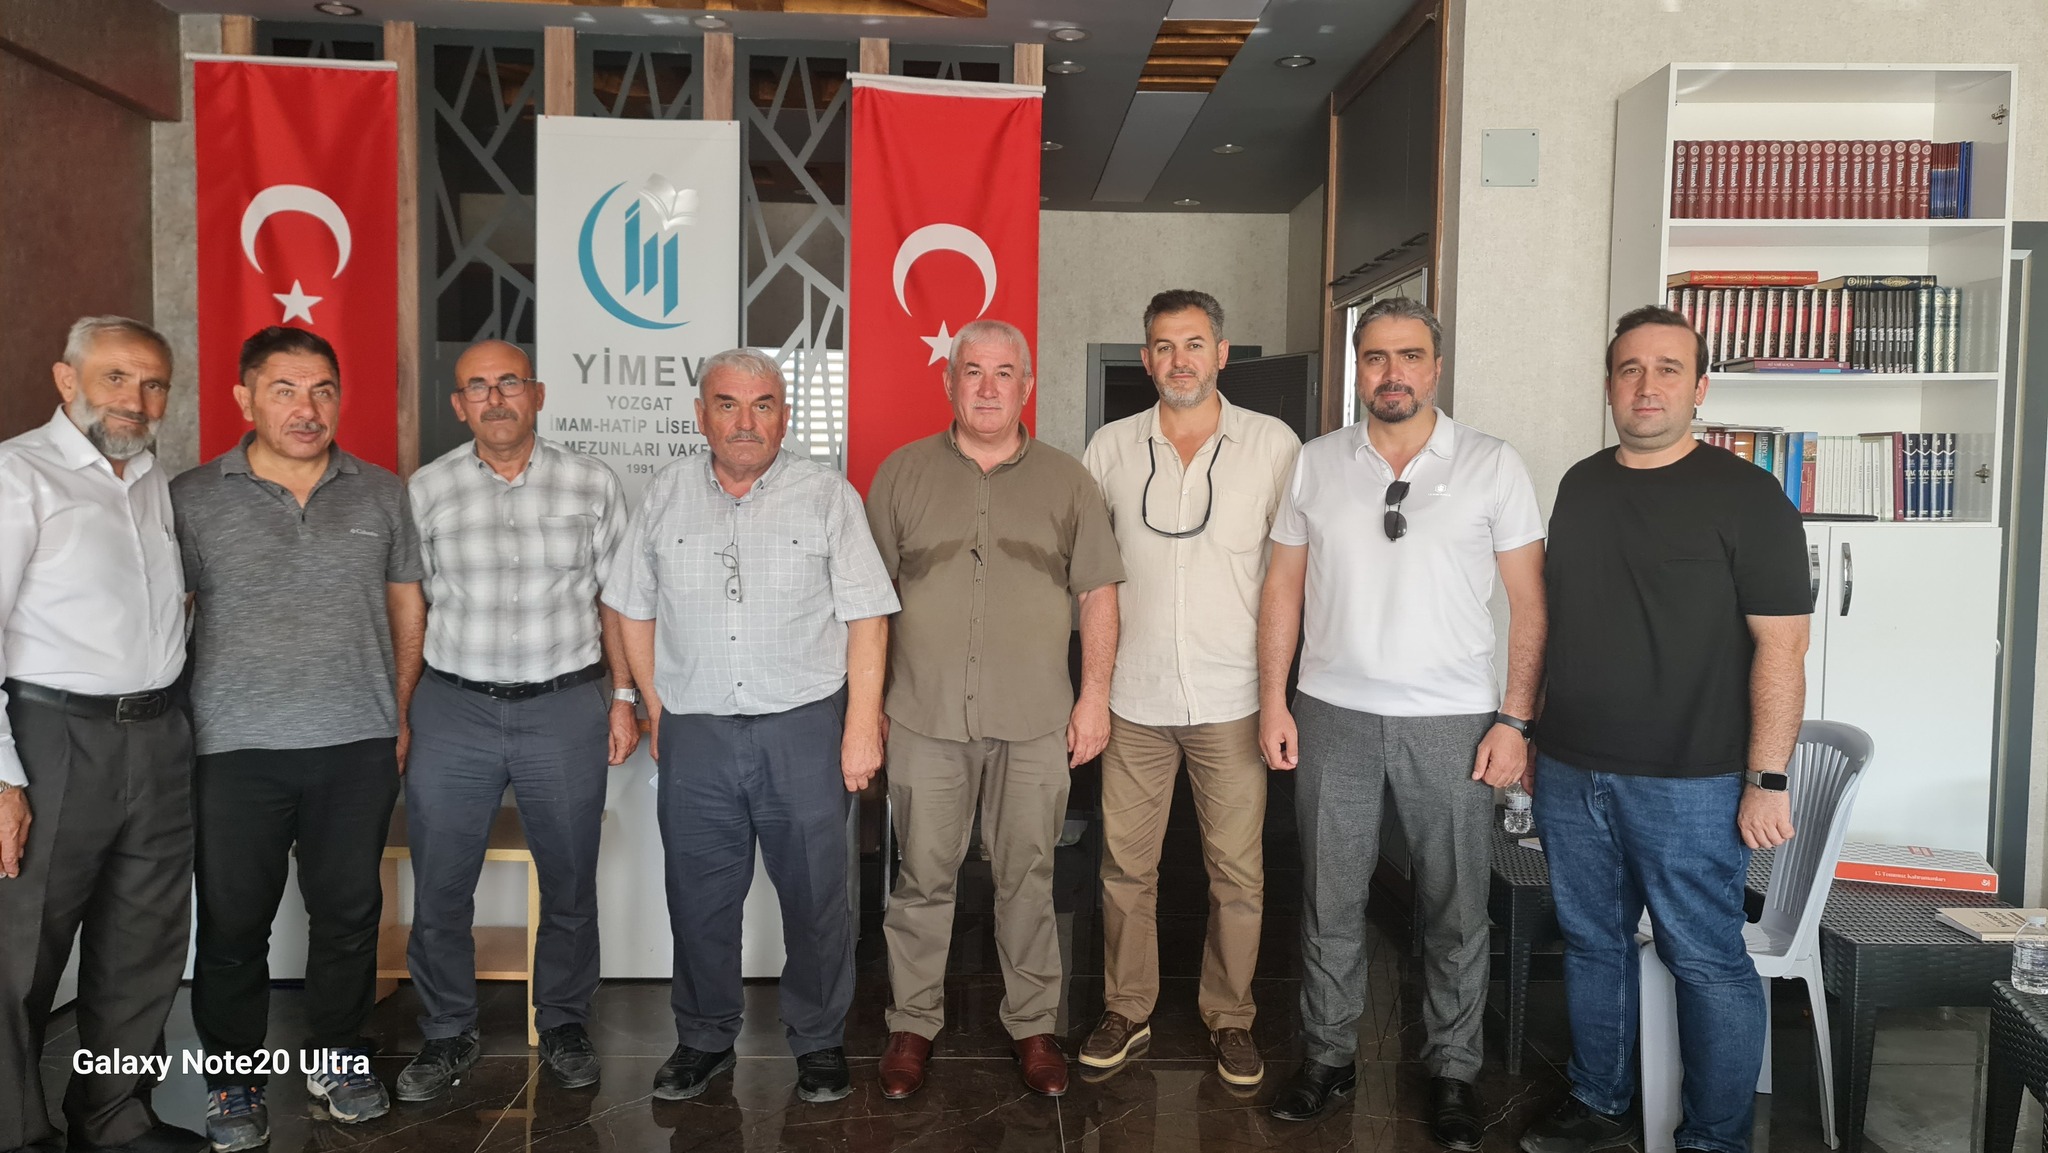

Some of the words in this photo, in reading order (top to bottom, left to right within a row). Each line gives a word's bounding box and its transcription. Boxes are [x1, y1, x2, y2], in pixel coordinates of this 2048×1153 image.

[572, 347, 705, 387] YİMEV
[607, 395, 672, 411] YOZGAT
[550, 414, 647, 434] İMAM-HATİP
[656, 416, 700, 434] LİSEL
[564, 441, 660, 457] MEZUNLARI
[668, 443, 709, 457] VAKF
[626, 463, 655, 474] 1991
